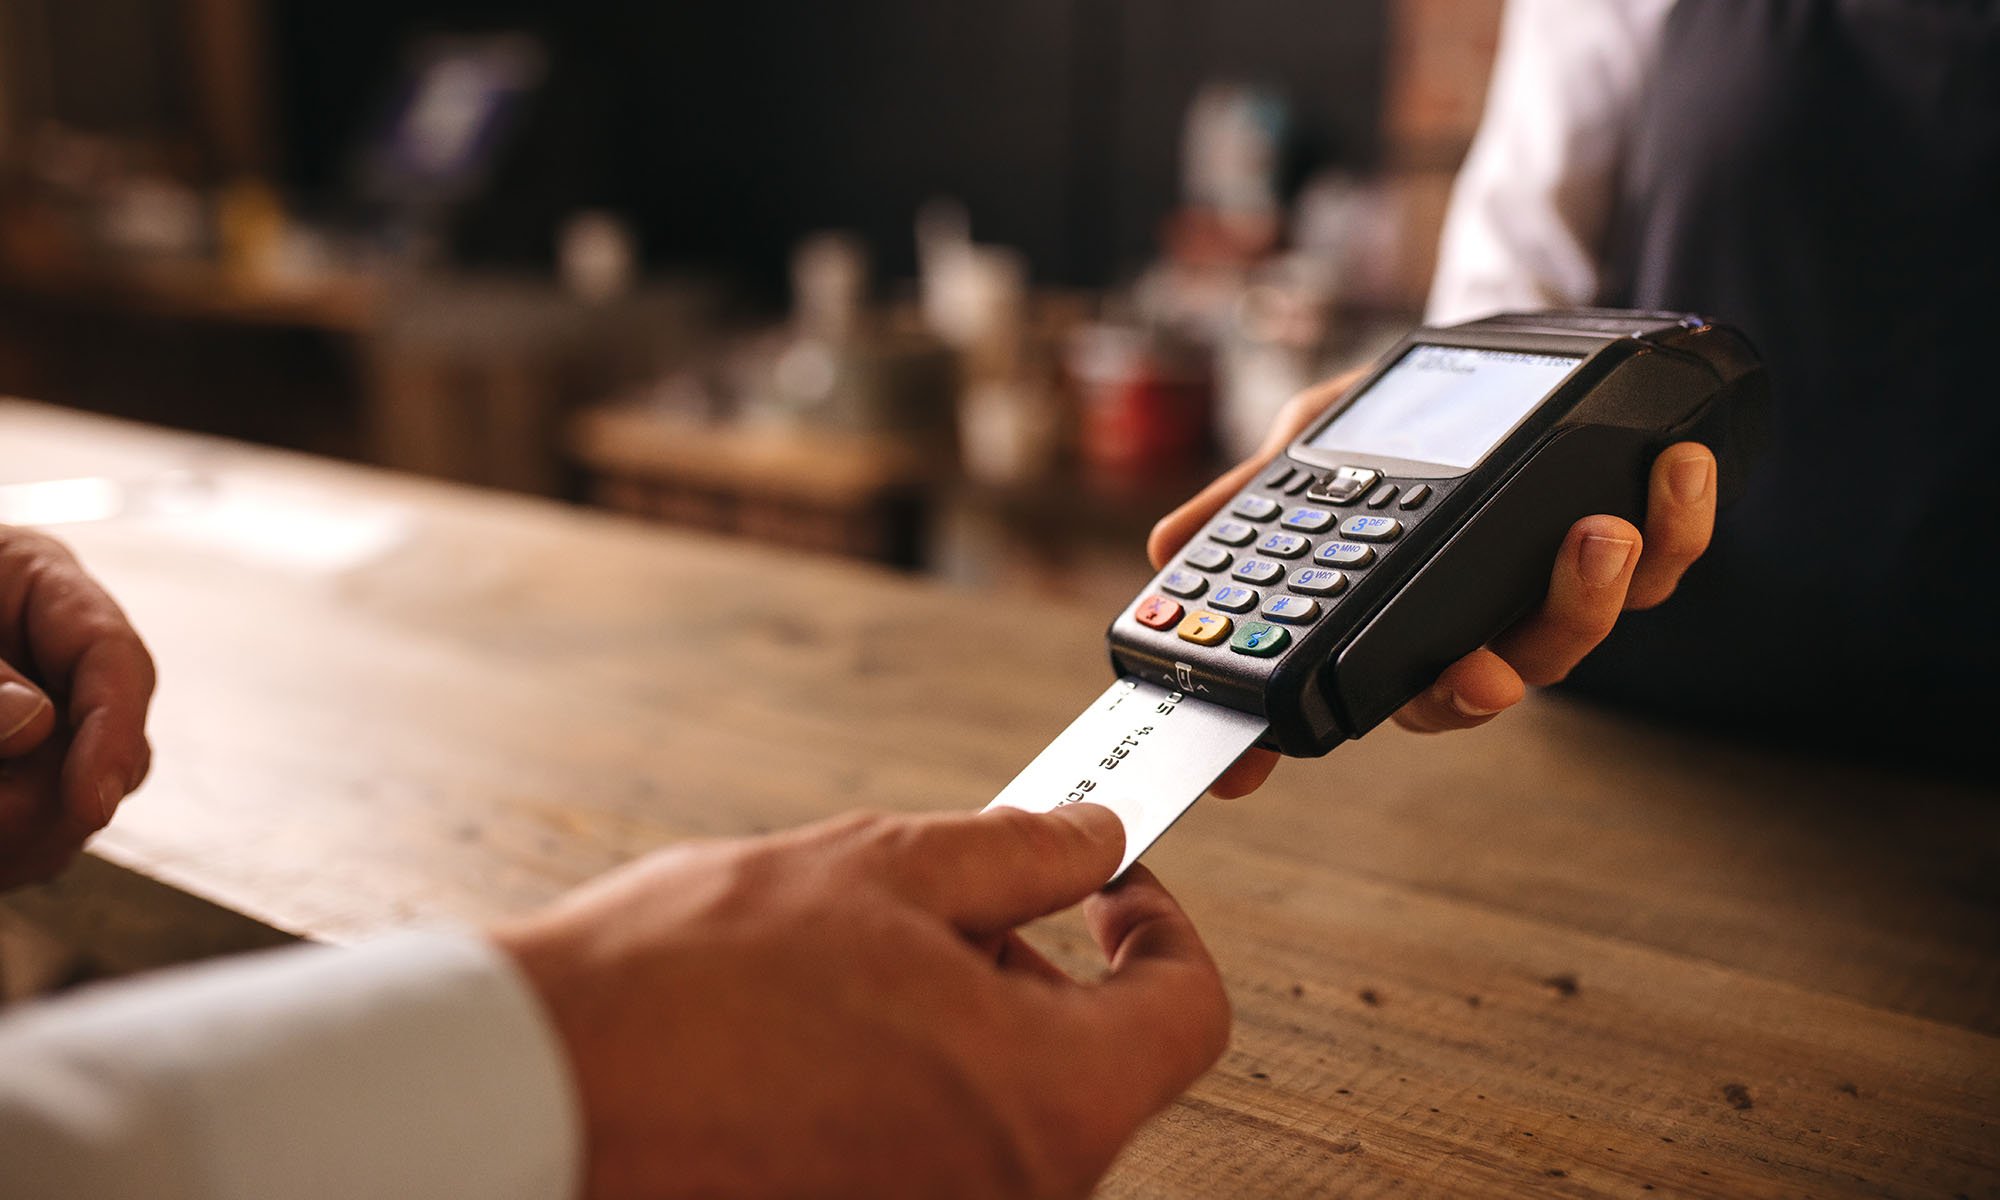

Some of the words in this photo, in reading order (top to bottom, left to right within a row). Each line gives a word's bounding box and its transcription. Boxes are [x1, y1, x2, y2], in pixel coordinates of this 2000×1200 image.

[1352, 518, 1368, 531] 3
[1368, 519, 1388, 527] DEF
[1265, 535, 1280, 548] 5
[1323, 543, 1340, 557] 6
[1341, 544, 1360, 553] MNO
[1240, 560, 1256, 574] 8
[1298, 570, 1314, 584] 9
[1315, 571, 1335, 580] WXY
[1215, 587, 1231, 601] 0
